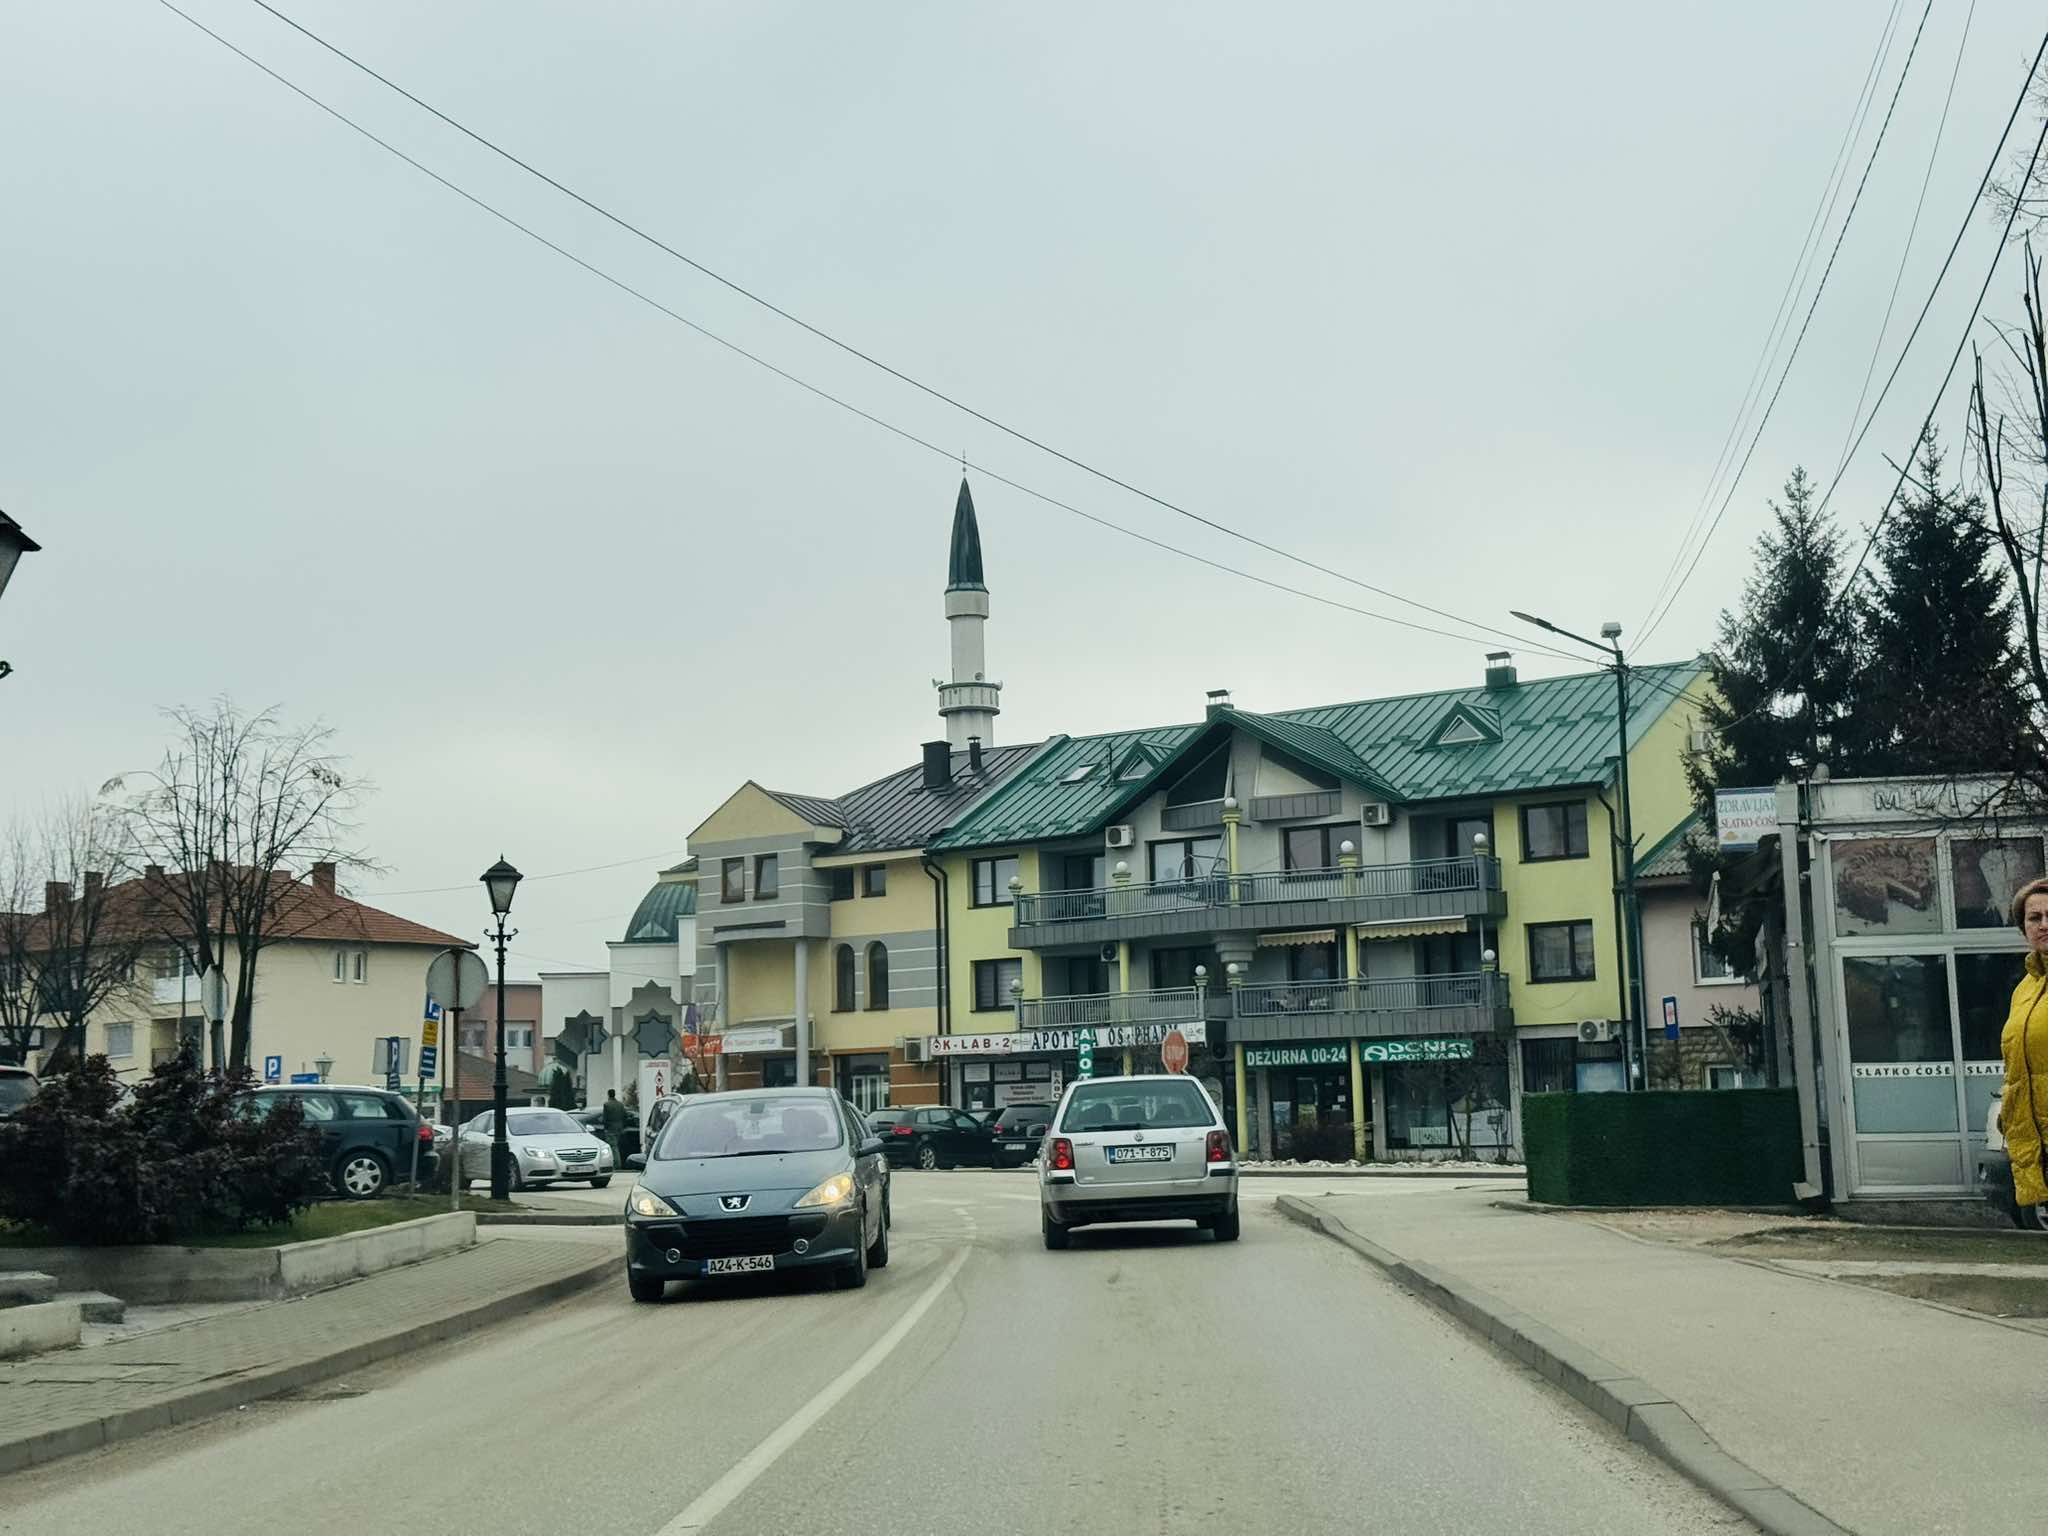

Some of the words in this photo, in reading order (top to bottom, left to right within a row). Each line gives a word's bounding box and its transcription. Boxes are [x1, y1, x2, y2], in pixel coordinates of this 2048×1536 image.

[1032, 1029, 1098, 1050] APOTEA
[1247, 1048, 1309, 1066] DEŽURNA
[1312, 1046, 1347, 1063] 00-24
[268, 1058, 278, 1077] P
[1856, 1067, 1910, 1077] SLATKO
[1966, 1065, 2001, 1075] SLAT
[1116, 1147, 1169, 1159] 071-T-875
[710, 1257, 771, 1272] A24-K-546
